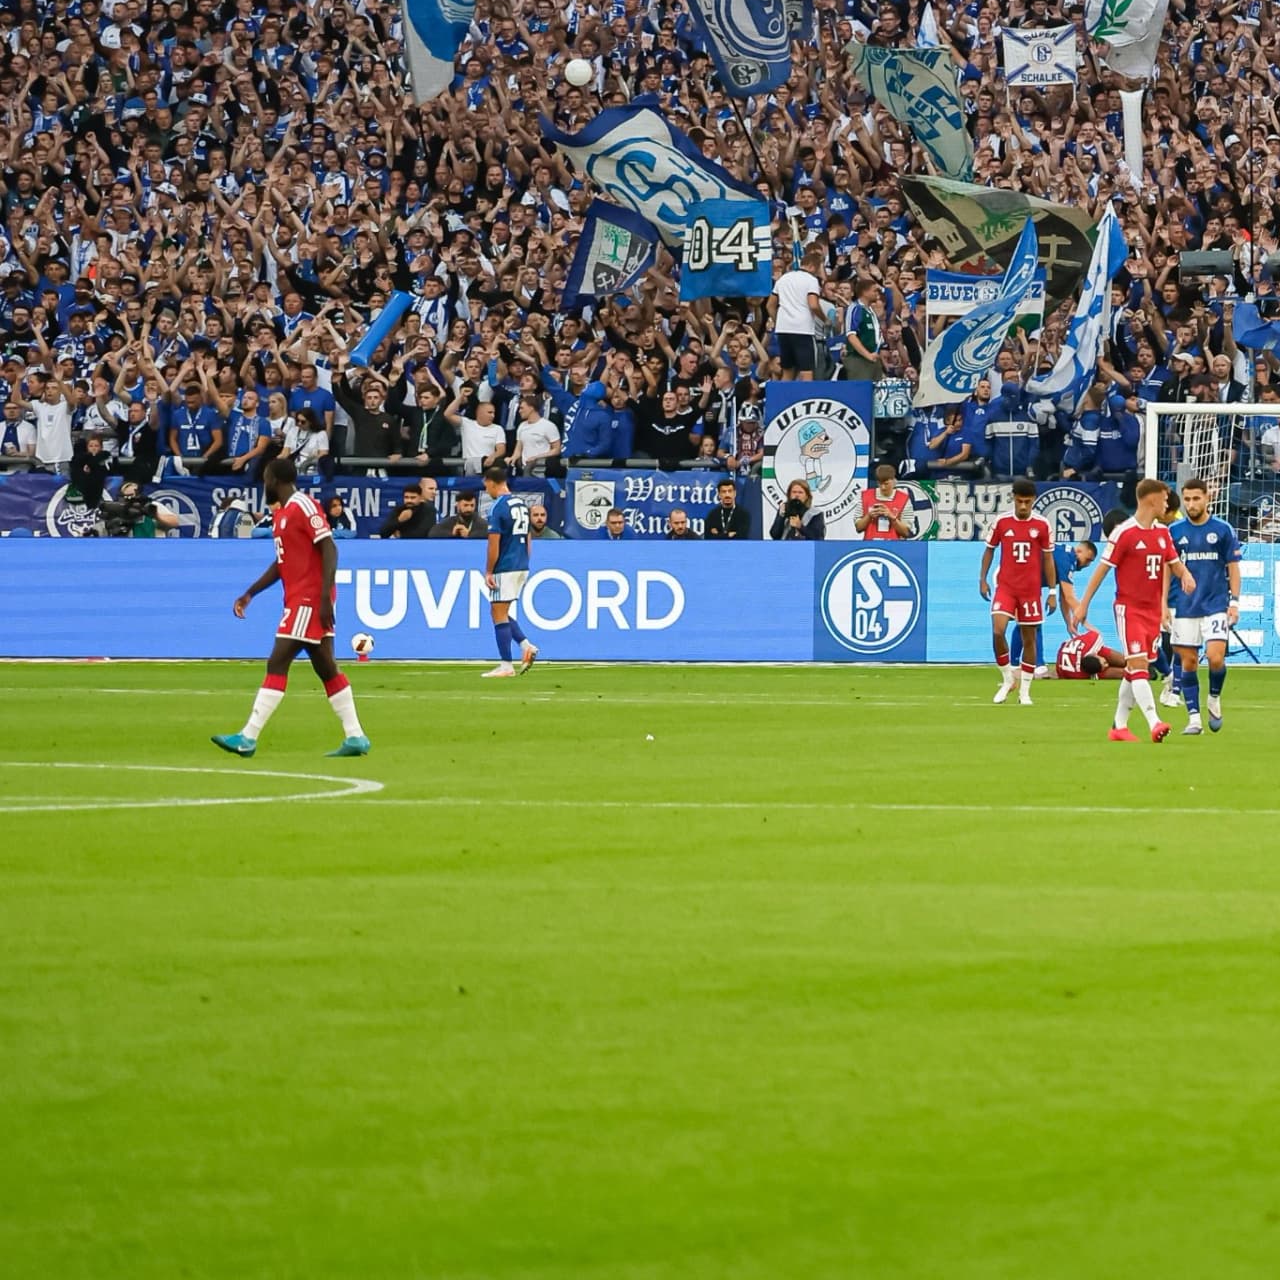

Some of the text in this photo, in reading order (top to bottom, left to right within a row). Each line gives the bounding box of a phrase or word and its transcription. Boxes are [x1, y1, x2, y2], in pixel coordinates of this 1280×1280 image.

[1024, 32, 1058, 42] SUPER
[1021, 73, 1063, 83] SCHALKE
[688, 217, 757, 272] 04
[777, 401, 861, 432] ULTRAS
[937, 481, 1014, 512] BLUE
[1022, 601, 1039, 618] 11
[1212, 620, 1228, 634] 24
